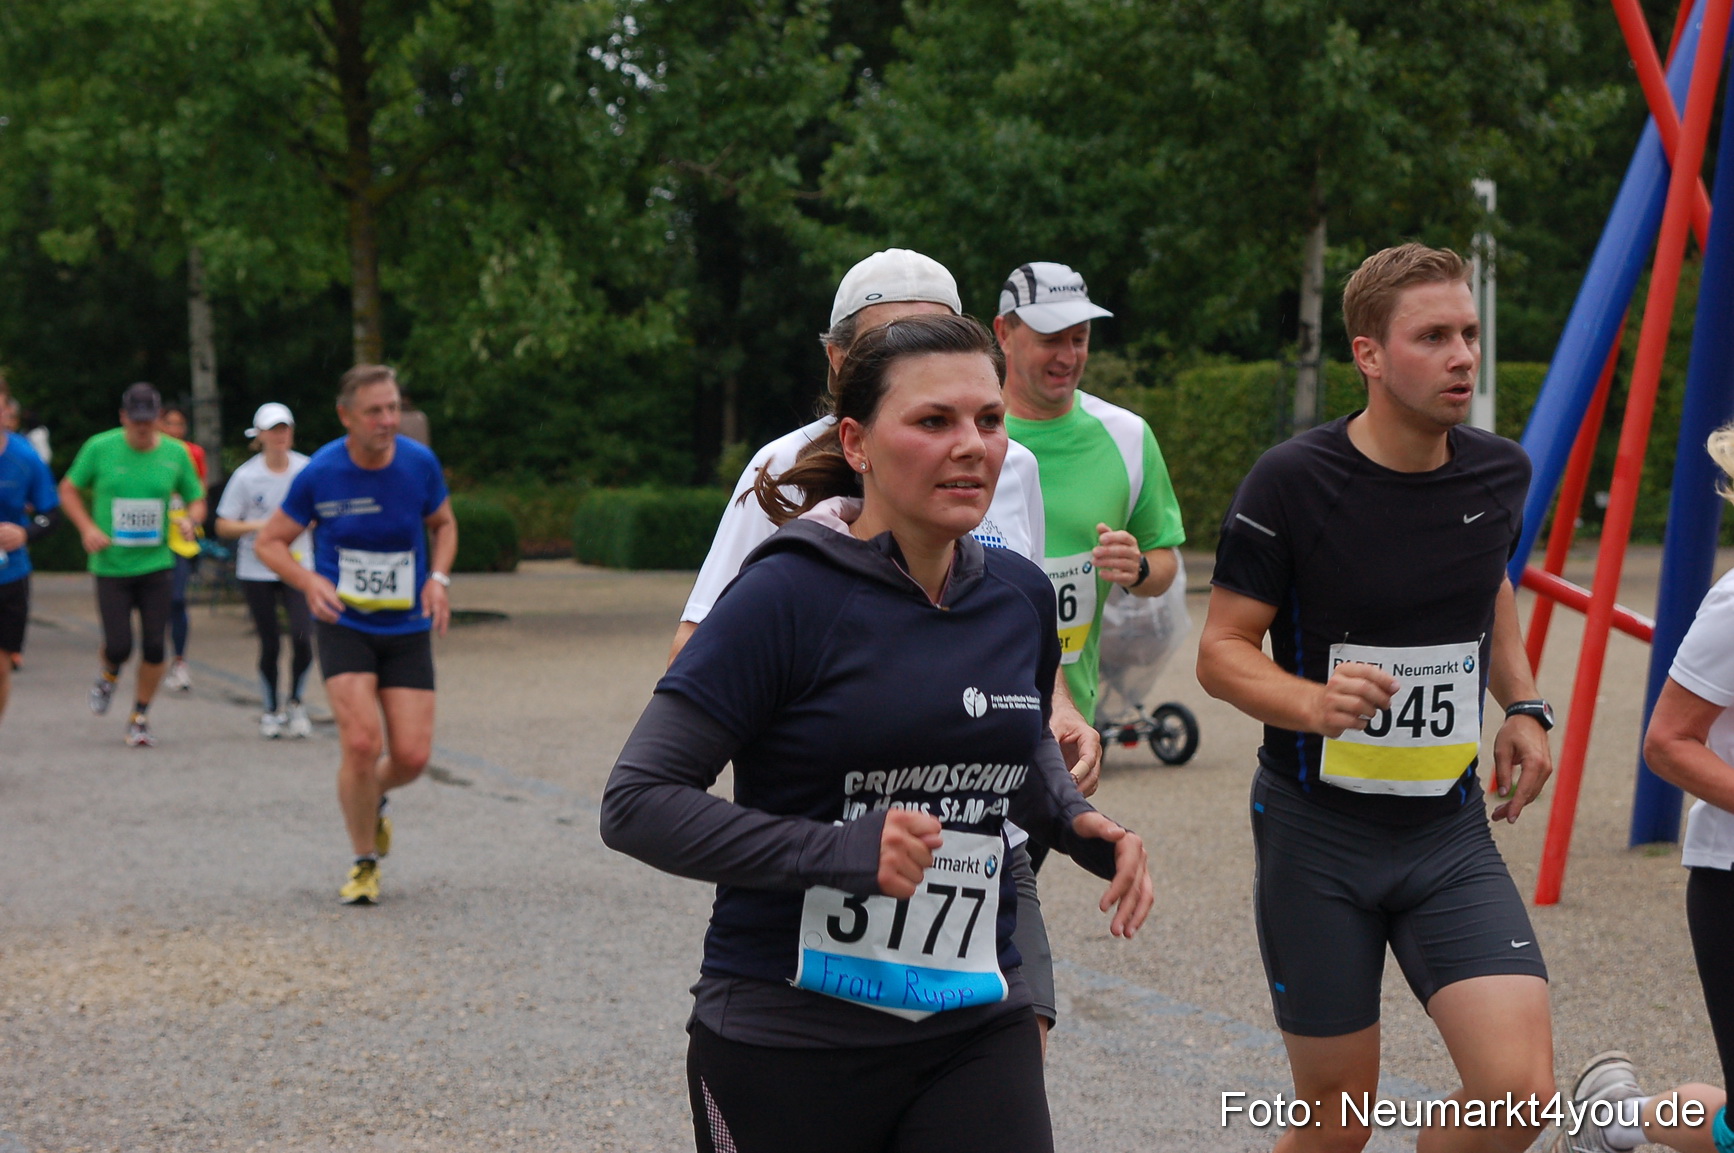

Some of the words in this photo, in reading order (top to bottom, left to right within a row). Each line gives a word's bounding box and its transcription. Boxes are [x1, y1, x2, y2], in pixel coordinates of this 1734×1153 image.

[355, 568, 398, 594] 554
[1392, 661, 1459, 677] Neumarkt
[826, 882, 987, 959] 3177
[820, 956, 883, 1001] Frau
[902, 968, 974, 1011] Rupp
